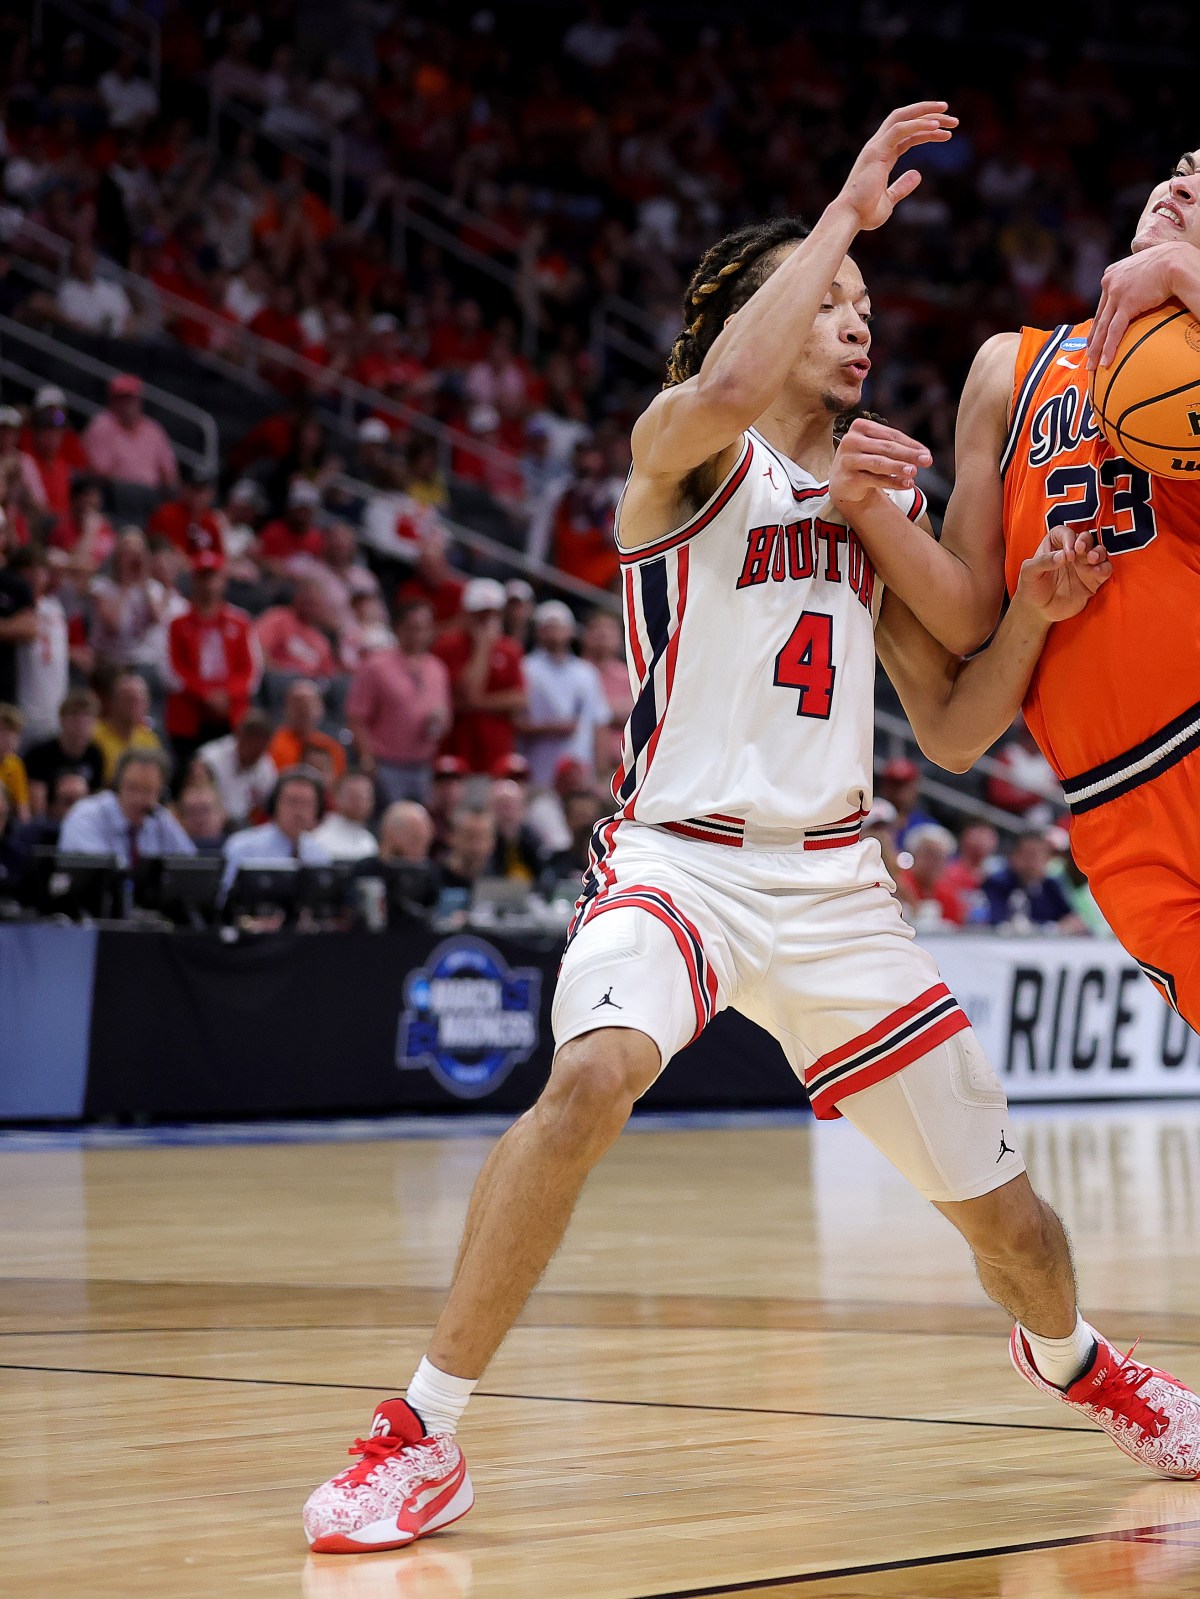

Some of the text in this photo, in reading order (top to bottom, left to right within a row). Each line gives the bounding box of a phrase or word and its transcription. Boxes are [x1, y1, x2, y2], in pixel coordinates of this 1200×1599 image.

[1028, 384, 1106, 468] Ill
[1045, 456, 1158, 557] 23
[772, 610, 836, 720] 4
[1006, 967, 1142, 1072] RICE
